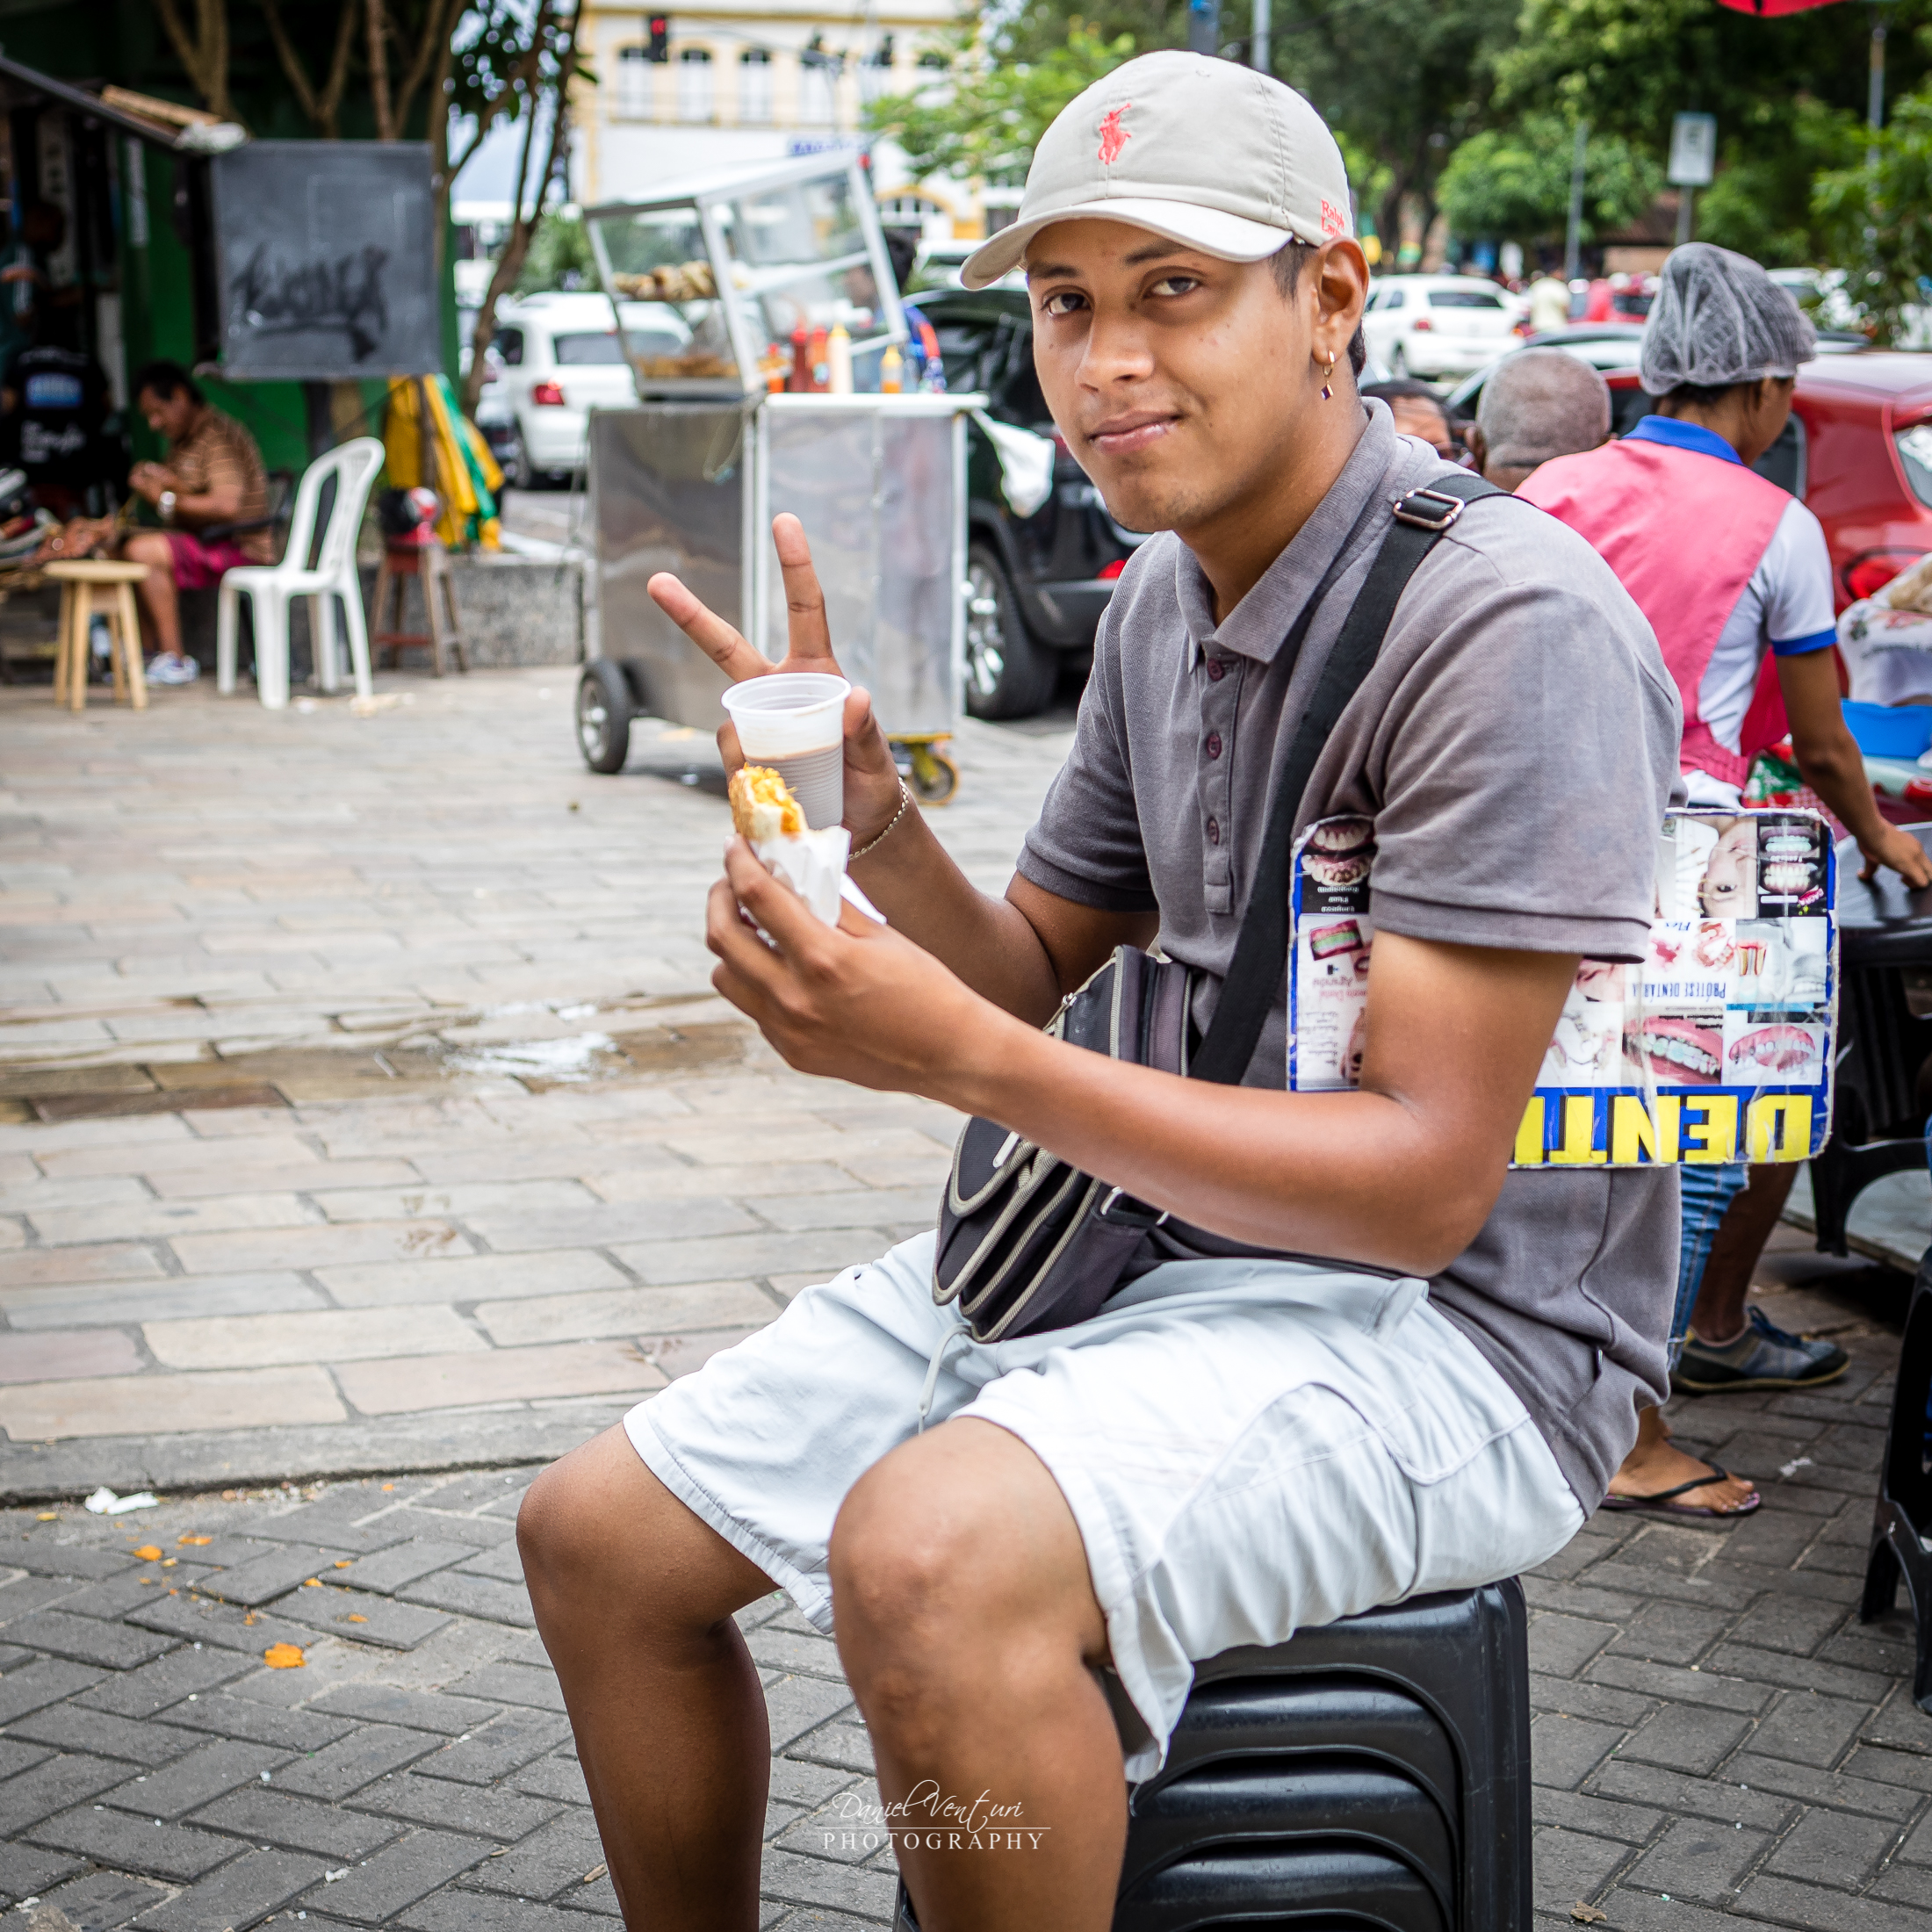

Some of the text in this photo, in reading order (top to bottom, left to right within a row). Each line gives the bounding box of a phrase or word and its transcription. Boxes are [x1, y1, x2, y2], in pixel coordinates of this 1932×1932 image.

[1321, 198, 1345, 230] Ralph
[1321, 215, 1343, 238] Lau
[1663, 920, 1691, 932] Flex
[1631, 982, 1727, 1003] PRÓTESE DENTÁRA
[1514, 1094, 1813, 1164] DENTI
